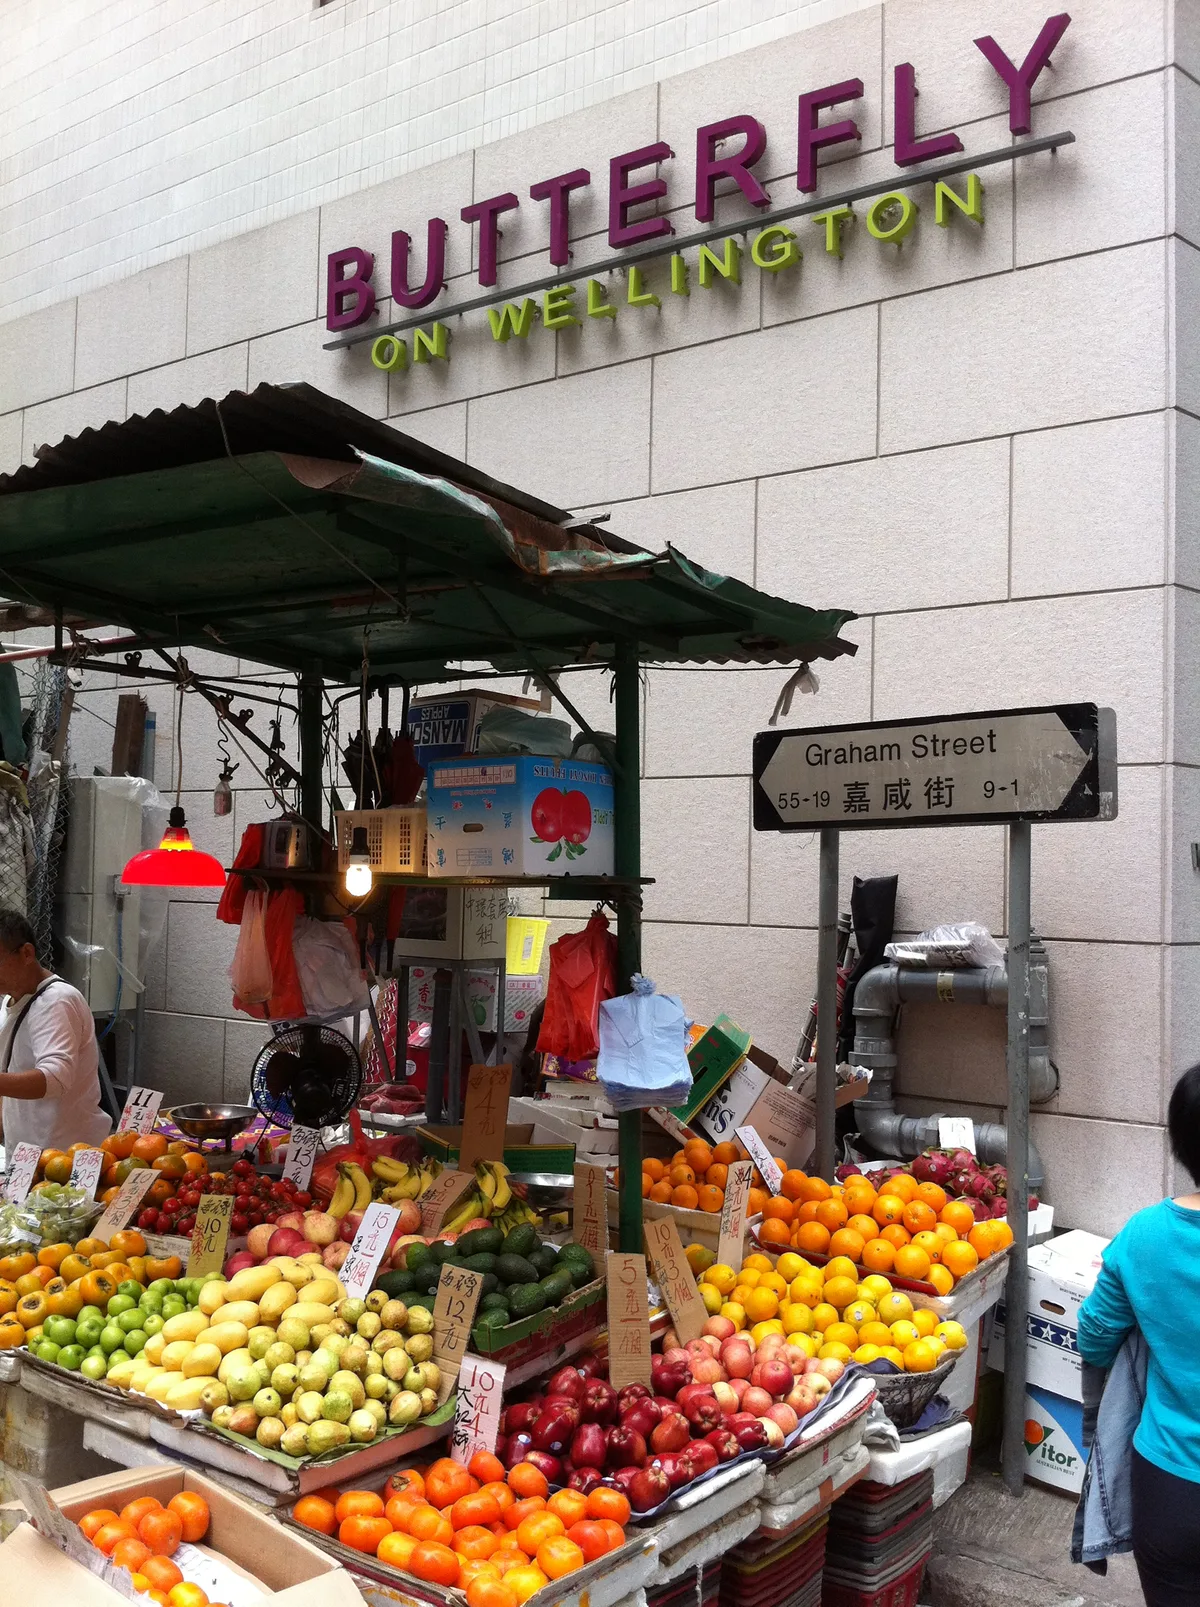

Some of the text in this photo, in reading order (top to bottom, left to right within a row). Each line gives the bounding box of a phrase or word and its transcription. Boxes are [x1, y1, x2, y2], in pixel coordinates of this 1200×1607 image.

[326, 12, 1072, 332] BUTTERFLY
[371, 174, 986, 374] ON WELLINGTON
[421, 706, 450, 720] APPLES
[804, 729, 997, 767] Graham Street
[843, 776, 955, 813] 嘉咸街
[291, 1146, 312, 1167] 13
[203, 1217, 222, 1235] 10
[445, 1295, 465, 1324] 12
